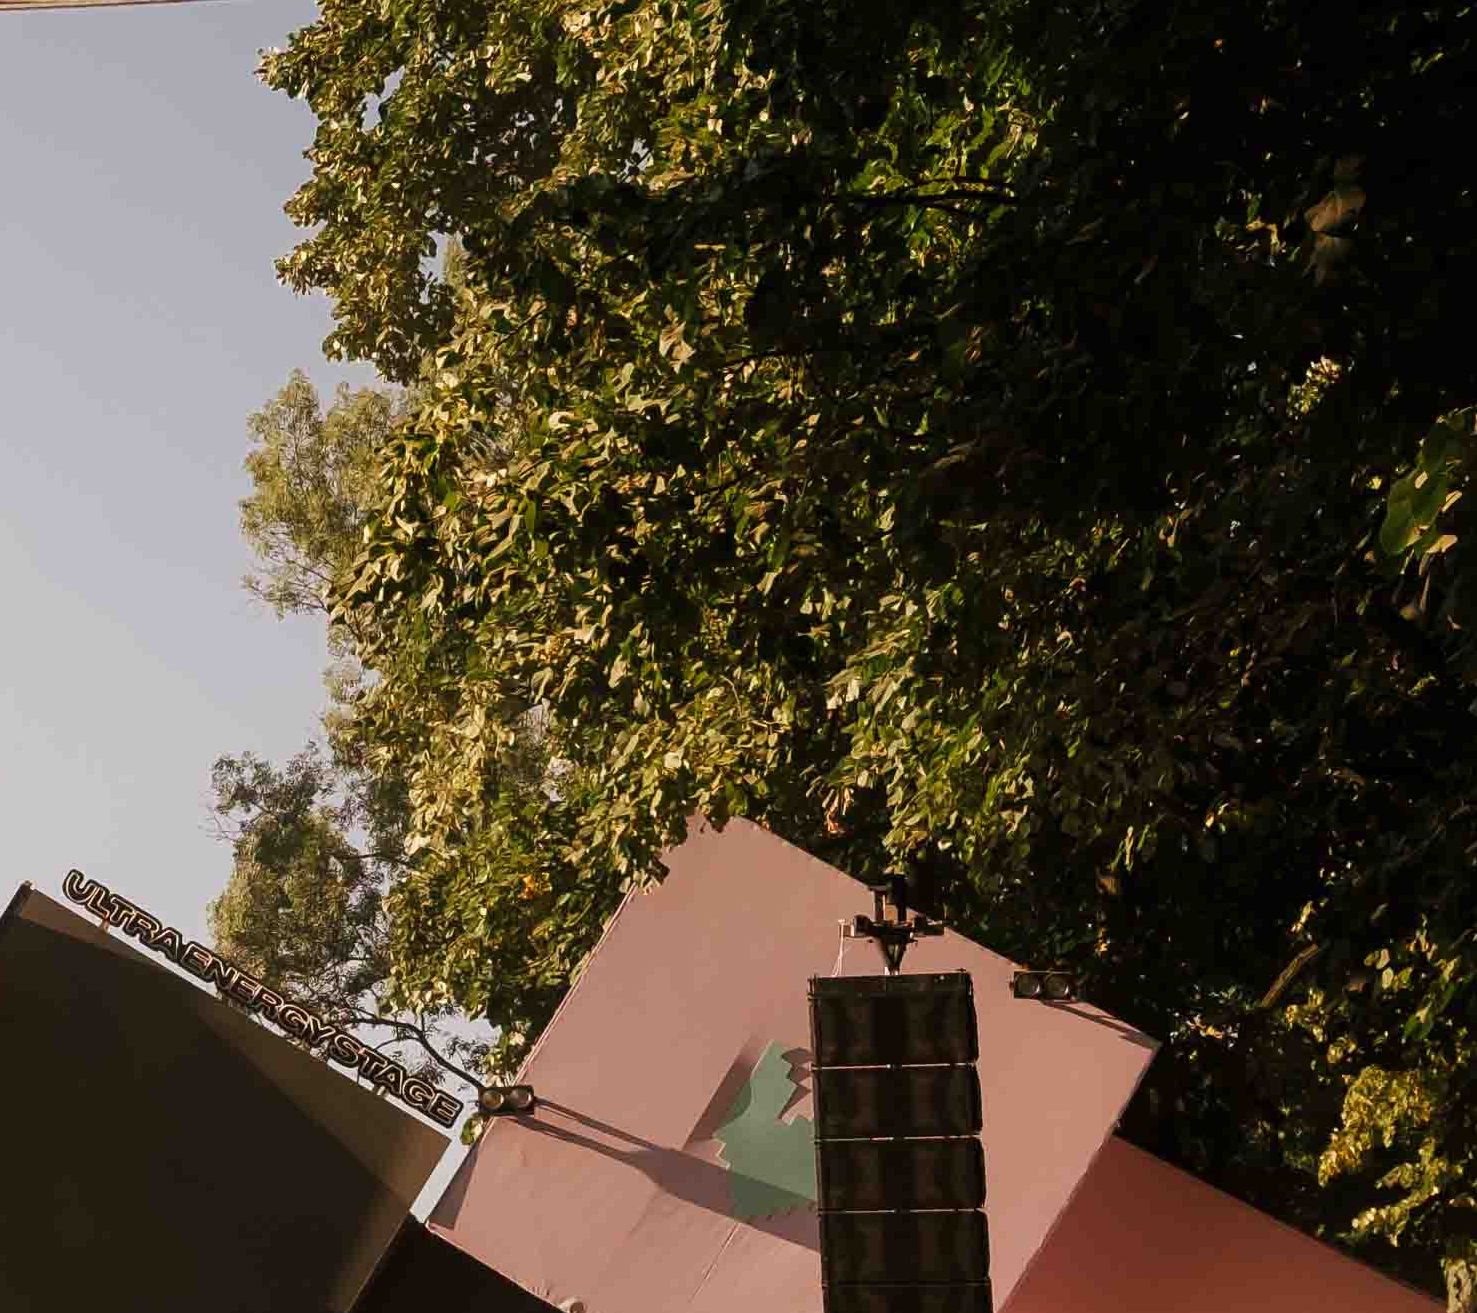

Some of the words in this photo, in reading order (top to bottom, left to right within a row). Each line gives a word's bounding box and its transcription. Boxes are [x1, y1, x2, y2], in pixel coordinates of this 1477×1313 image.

[63, 869, 182, 962] ULTRA
[180, 941, 336, 1047] ENERGY
[328, 1034, 464, 1128] STAGE
